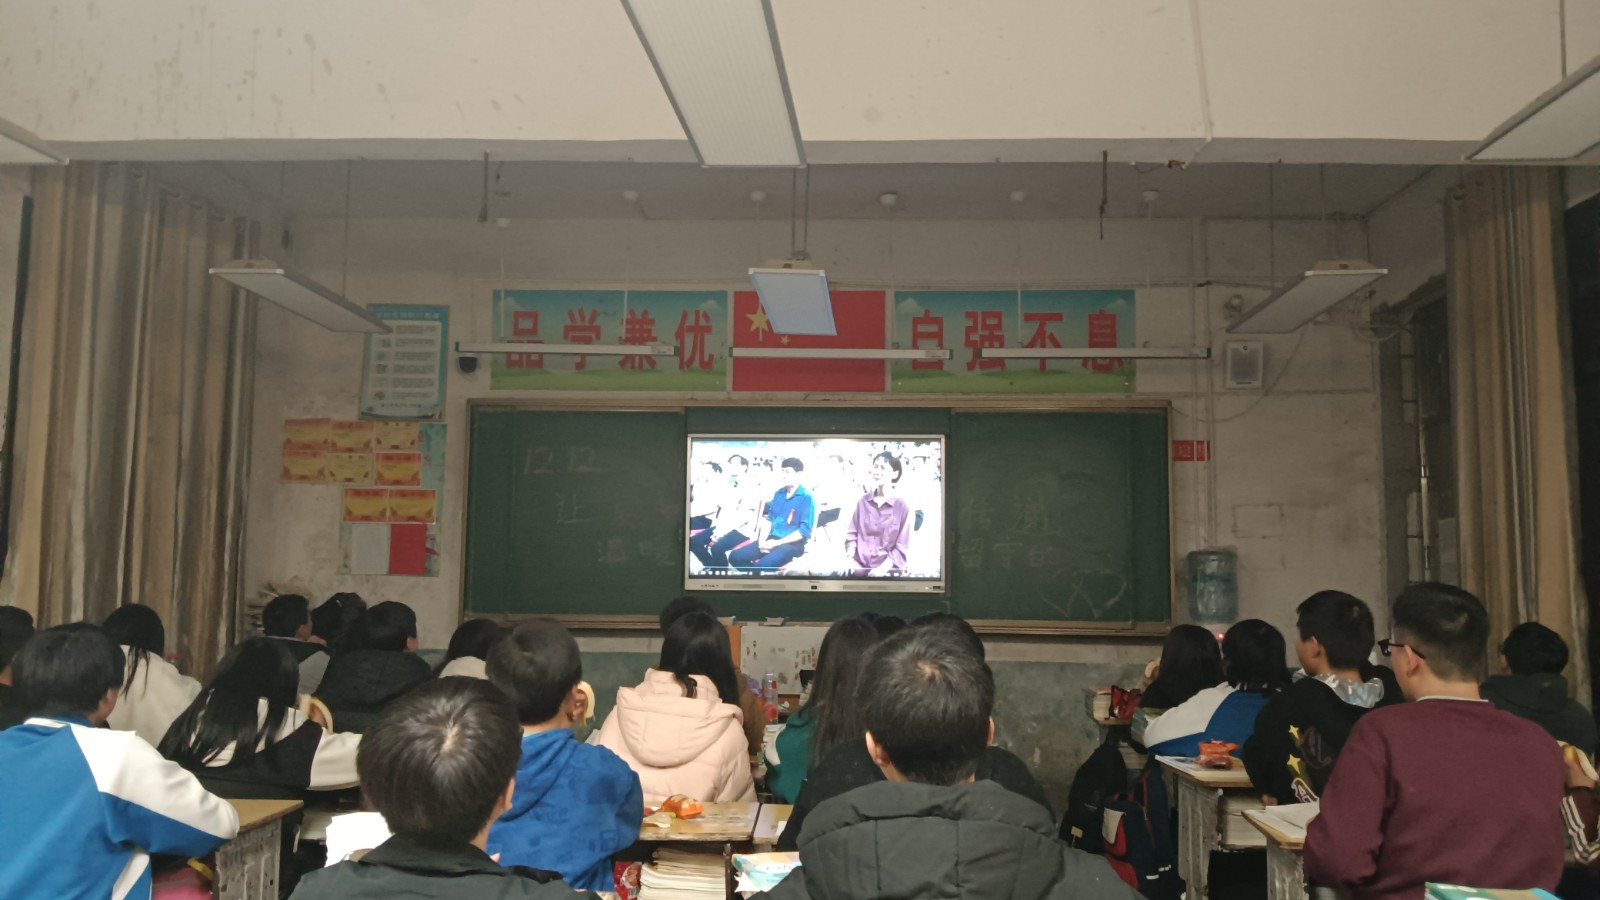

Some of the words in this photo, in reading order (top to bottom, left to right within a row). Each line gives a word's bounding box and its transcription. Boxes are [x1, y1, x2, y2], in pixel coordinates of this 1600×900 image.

[506, 307, 714, 370] 品学兼优
[911, 309, 1124, 372] 自强不息
